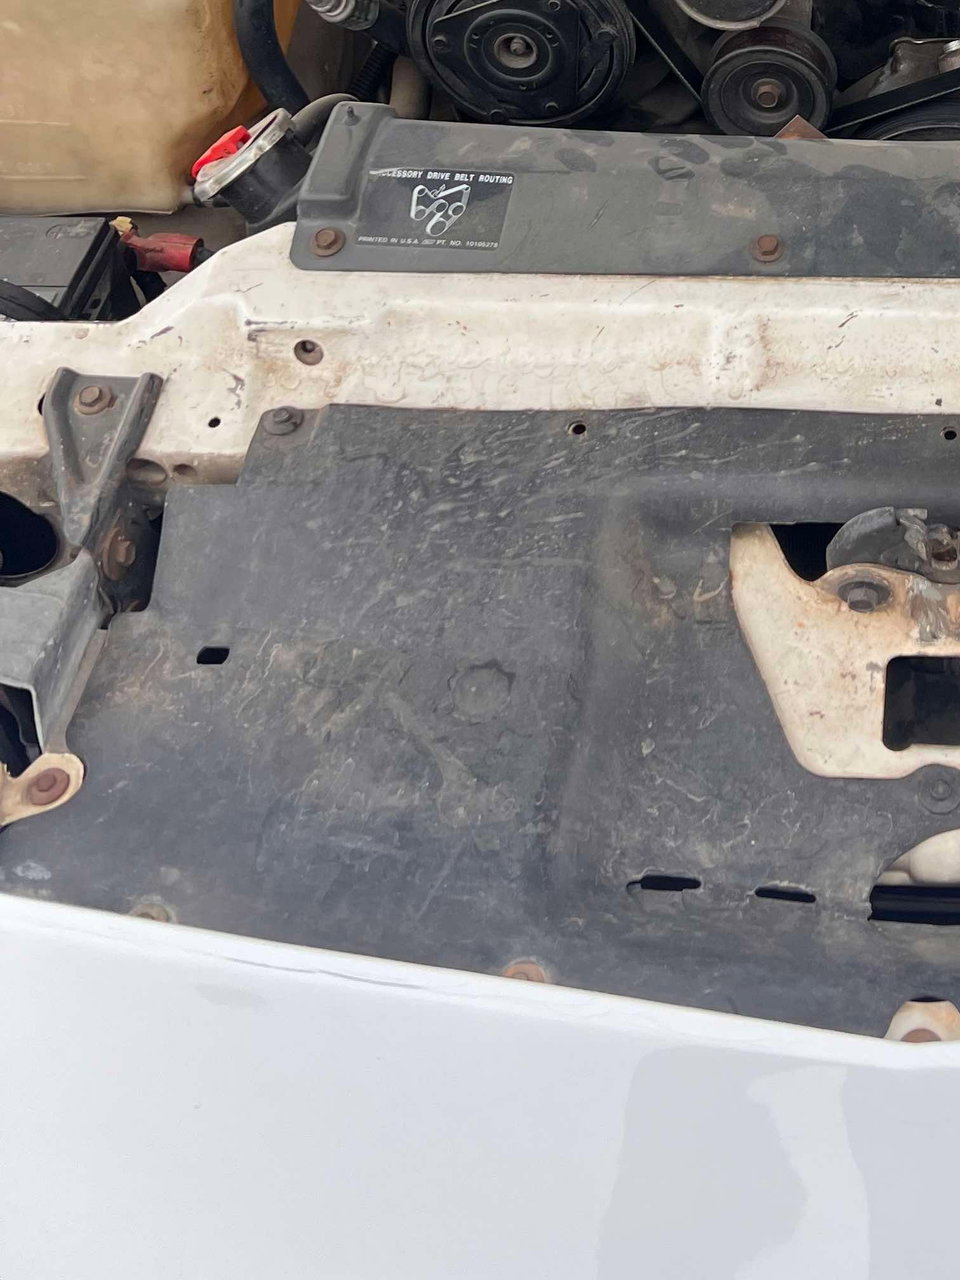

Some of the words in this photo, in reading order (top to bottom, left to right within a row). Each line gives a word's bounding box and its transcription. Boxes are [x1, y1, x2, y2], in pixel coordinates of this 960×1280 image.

[379, 170, 423, 179] CCESSORY
[426, 171, 451, 180] DRIVE
[454, 172, 475, 182] BELT
[478, 174, 514, 184] ROUTING
